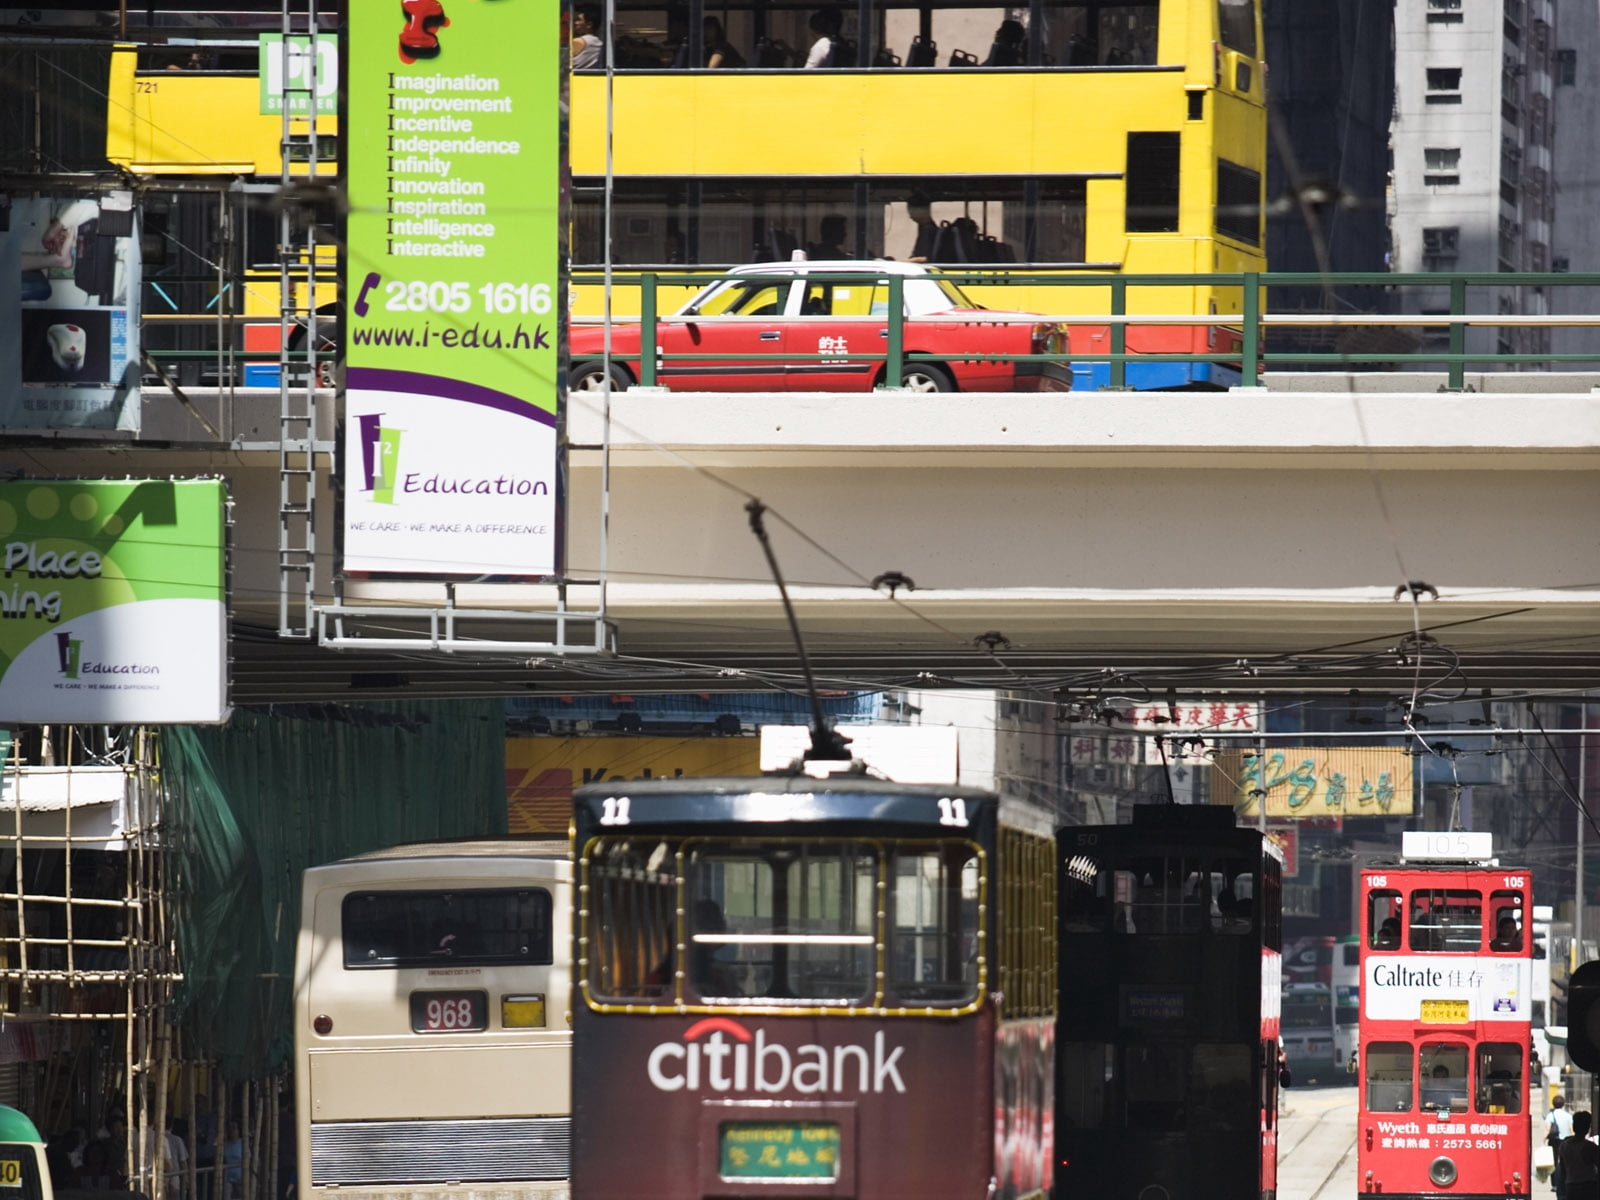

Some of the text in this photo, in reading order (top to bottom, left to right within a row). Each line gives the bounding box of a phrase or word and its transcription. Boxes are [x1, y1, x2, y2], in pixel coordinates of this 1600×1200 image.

[136, 81, 159, 93] 721
[388, 72, 500, 94] Imagination
[388, 93, 512, 114] Improvement
[388, 114, 473, 132] Incentive
[387, 135, 520, 156] Independence
[387, 156, 451, 177] Infinity
[387, 176, 485, 195] Innovation
[387, 197, 486, 218] Inspiration
[387, 218, 496, 240] Intelligence
[386, 238, 486, 257] Interactive
[385, 280, 471, 313] 2805
[478, 282, 552, 314] 1616
[352, 321, 551, 349] www.i-edu.hk
[818, 335, 848, 350] 的士
[403, 472, 549, 496] Education
[350, 521, 548, 535] WE CARE WE MAKE A DIFFERENCE
[5, 541, 102, 577] Place
[81, 662, 160, 674] Education
[600, 796, 631, 826] 11
[937, 797, 969, 827] 11
[1426, 835, 1470, 855] 105
[1366, 876, 1387, 887] 105
[1503, 876, 1524, 888] 105
[1373, 964, 1442, 987] Caltrate
[427, 998, 473, 1029] 968
[647, 1026, 907, 1094] citibank
[1377, 1121, 1420, 1136] Wyeth
[1442, 1139, 1473, 1150] 2573
[1475, 1139, 1503, 1150] 5661
